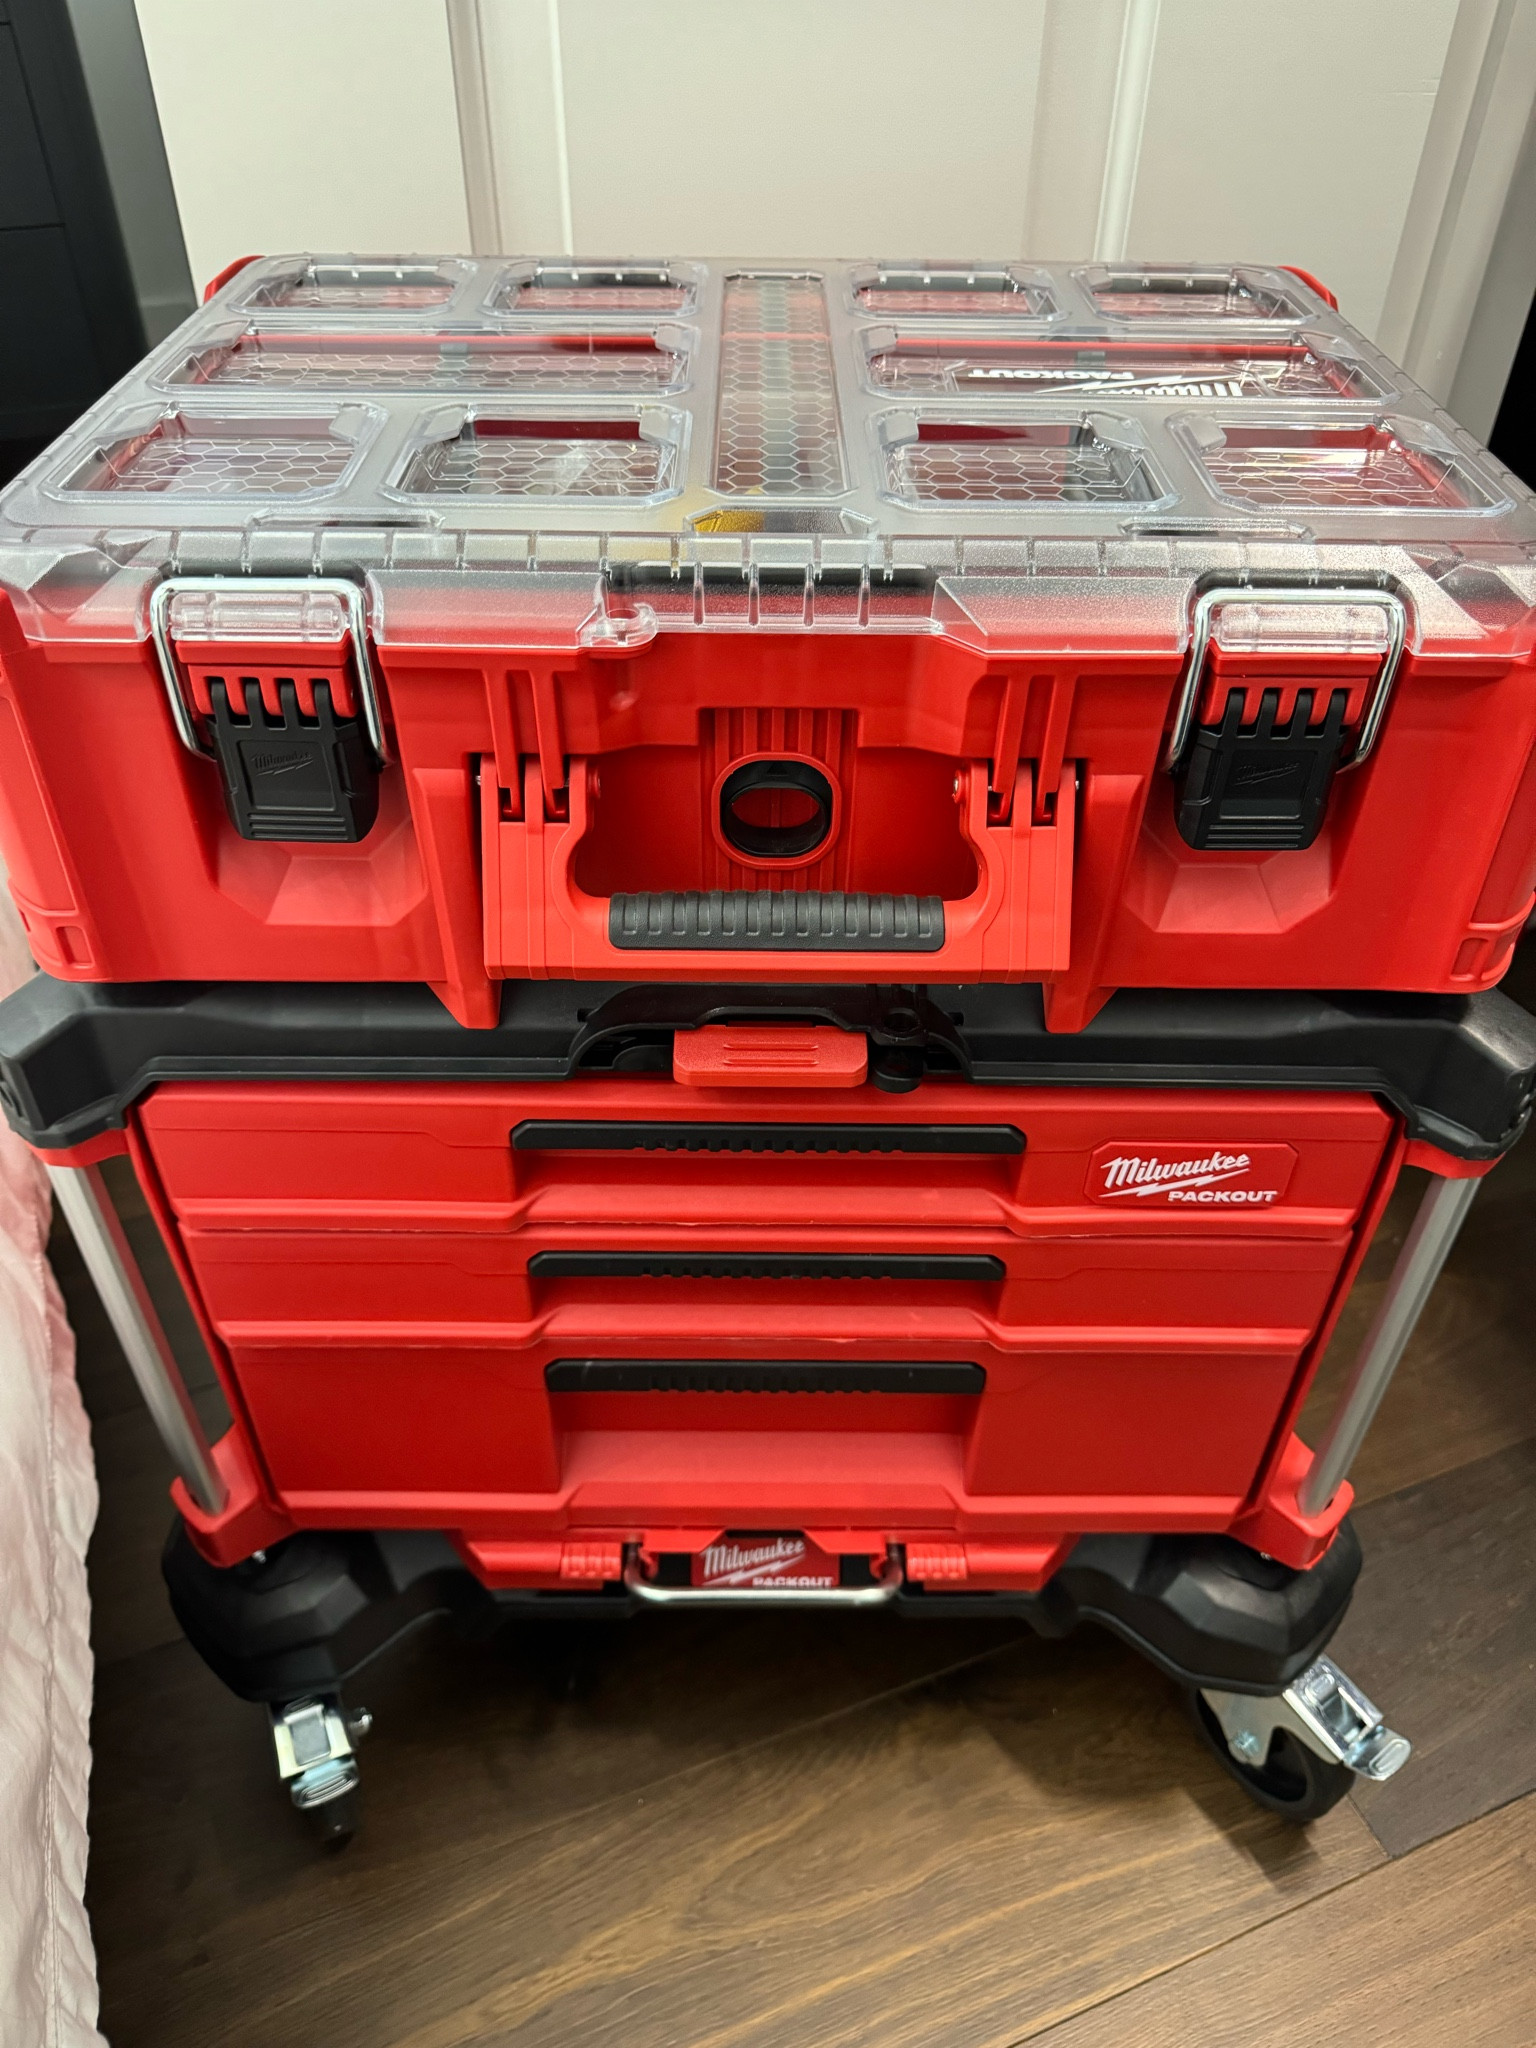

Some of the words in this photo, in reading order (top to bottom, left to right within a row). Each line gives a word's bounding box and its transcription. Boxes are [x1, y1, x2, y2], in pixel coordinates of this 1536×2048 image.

[968, 369, 1134, 380] PACKOUT
[1101, 1152, 1249, 1188] Milwaukee
[1168, 1190, 1277, 1202] PACKOUT
[700, 1538, 805, 1578] Milwaukee
[752, 1576, 832, 1587] PACKOUT
